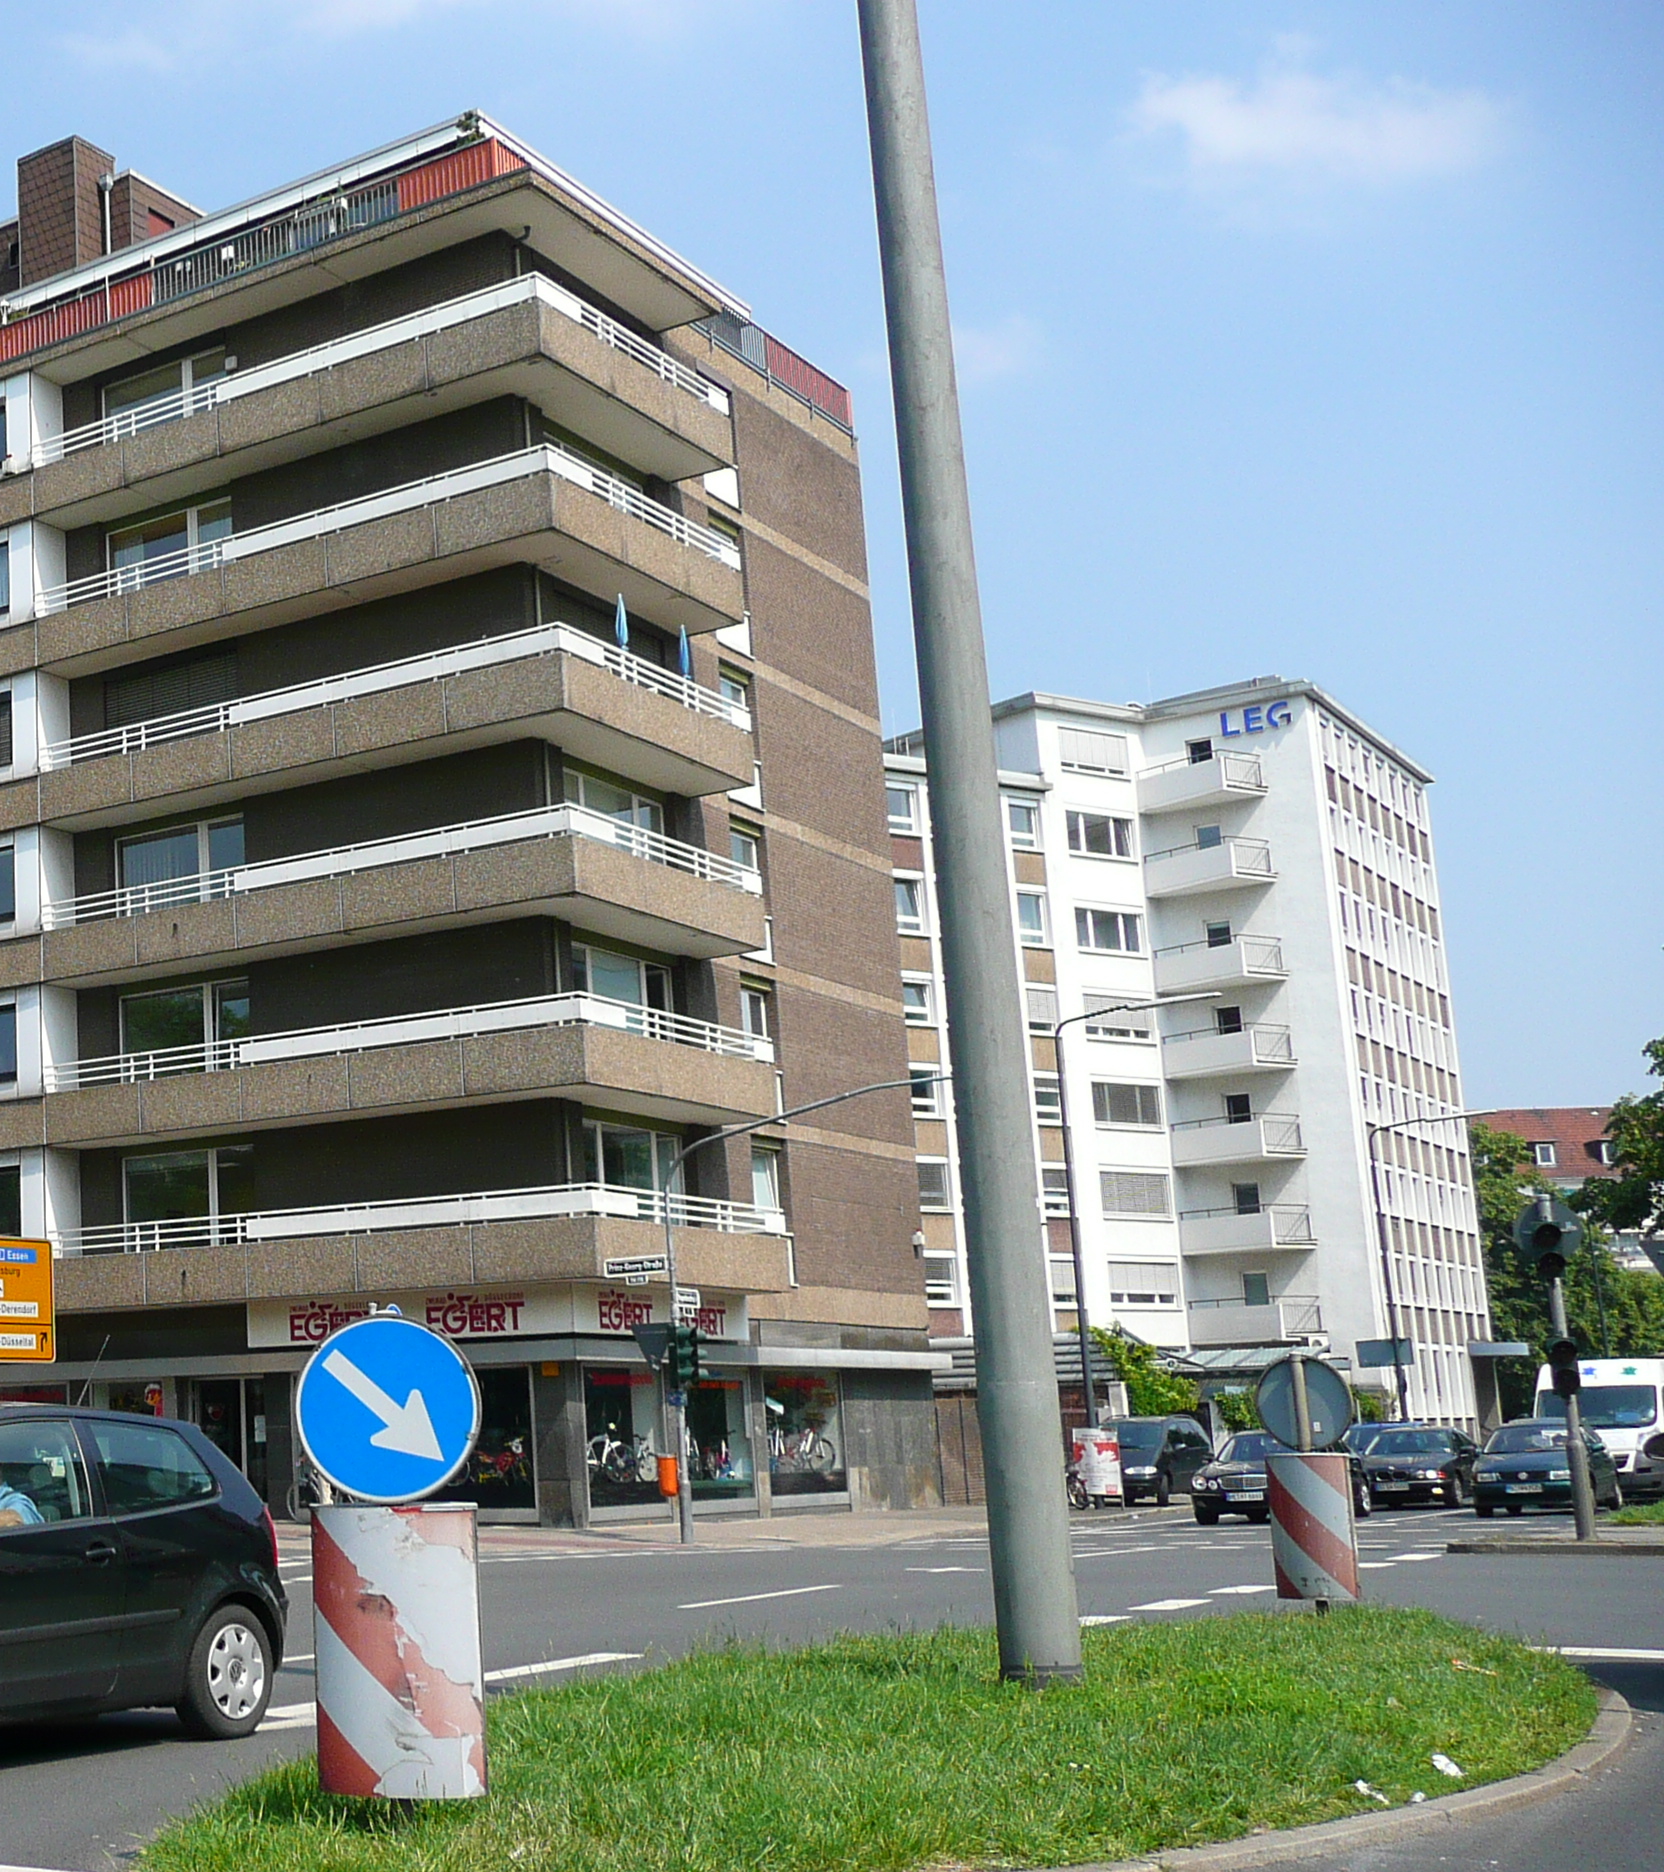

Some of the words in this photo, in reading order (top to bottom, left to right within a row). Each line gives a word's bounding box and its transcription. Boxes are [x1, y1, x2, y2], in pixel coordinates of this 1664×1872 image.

[1220, 701, 1292, 736] LEG
[7, 1250, 29, 1260] Essen
[426, 1301, 525, 1335] EGERT
[598, 1300, 654, 1331] EGERT
